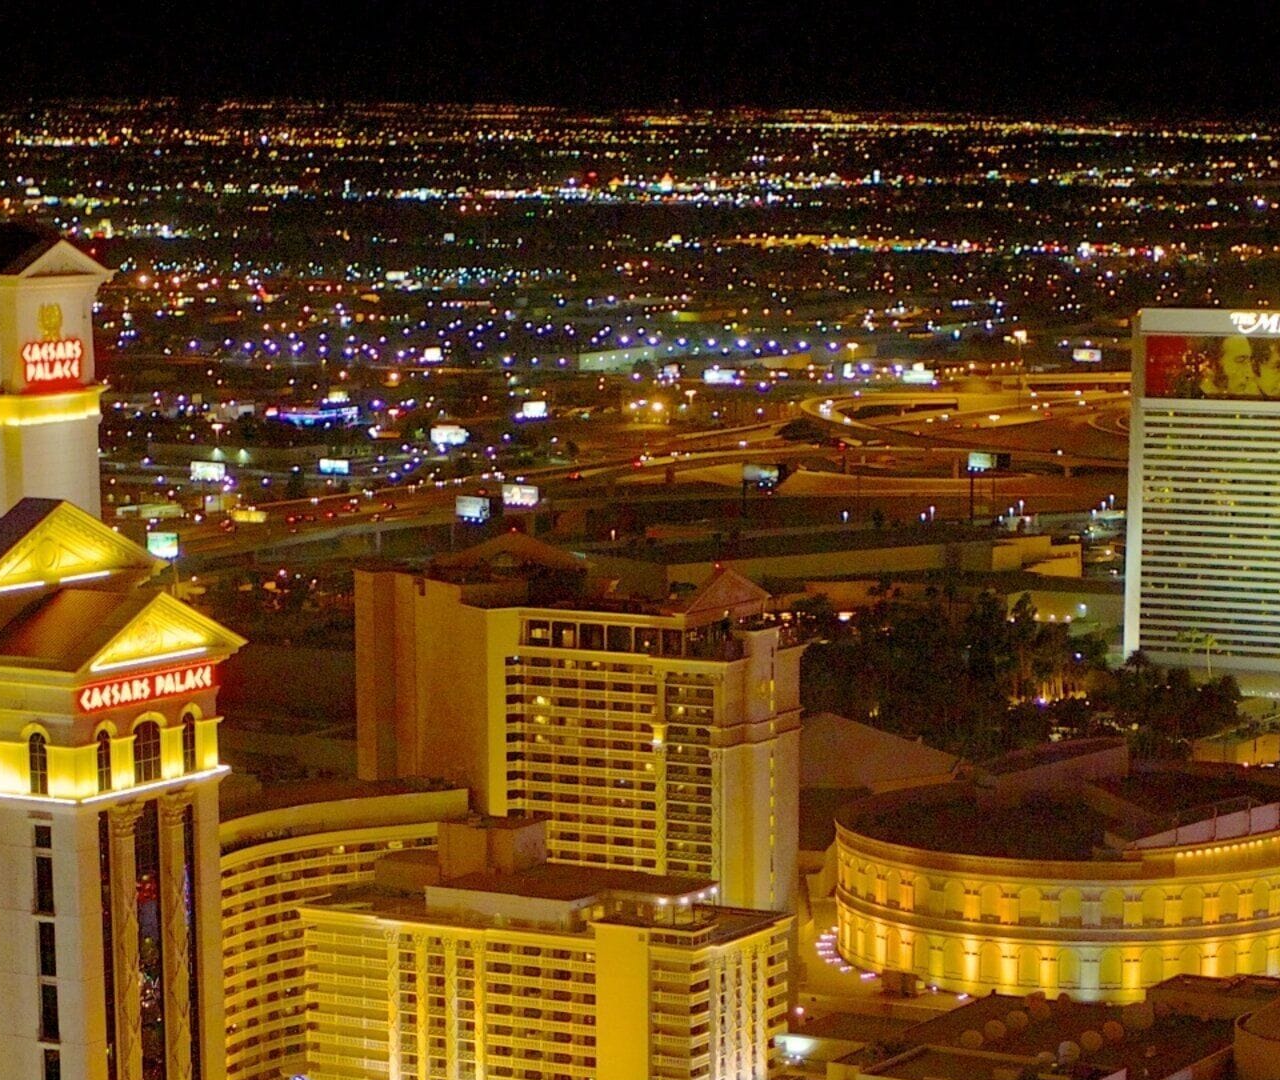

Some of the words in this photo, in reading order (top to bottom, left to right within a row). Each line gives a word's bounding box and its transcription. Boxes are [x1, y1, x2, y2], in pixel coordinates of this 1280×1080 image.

[22, 340, 81, 362] CAESARS
[26, 359, 79, 382] PALACE
[80, 677, 151, 711] CAESARS
[155, 665, 212, 696] PALACE
